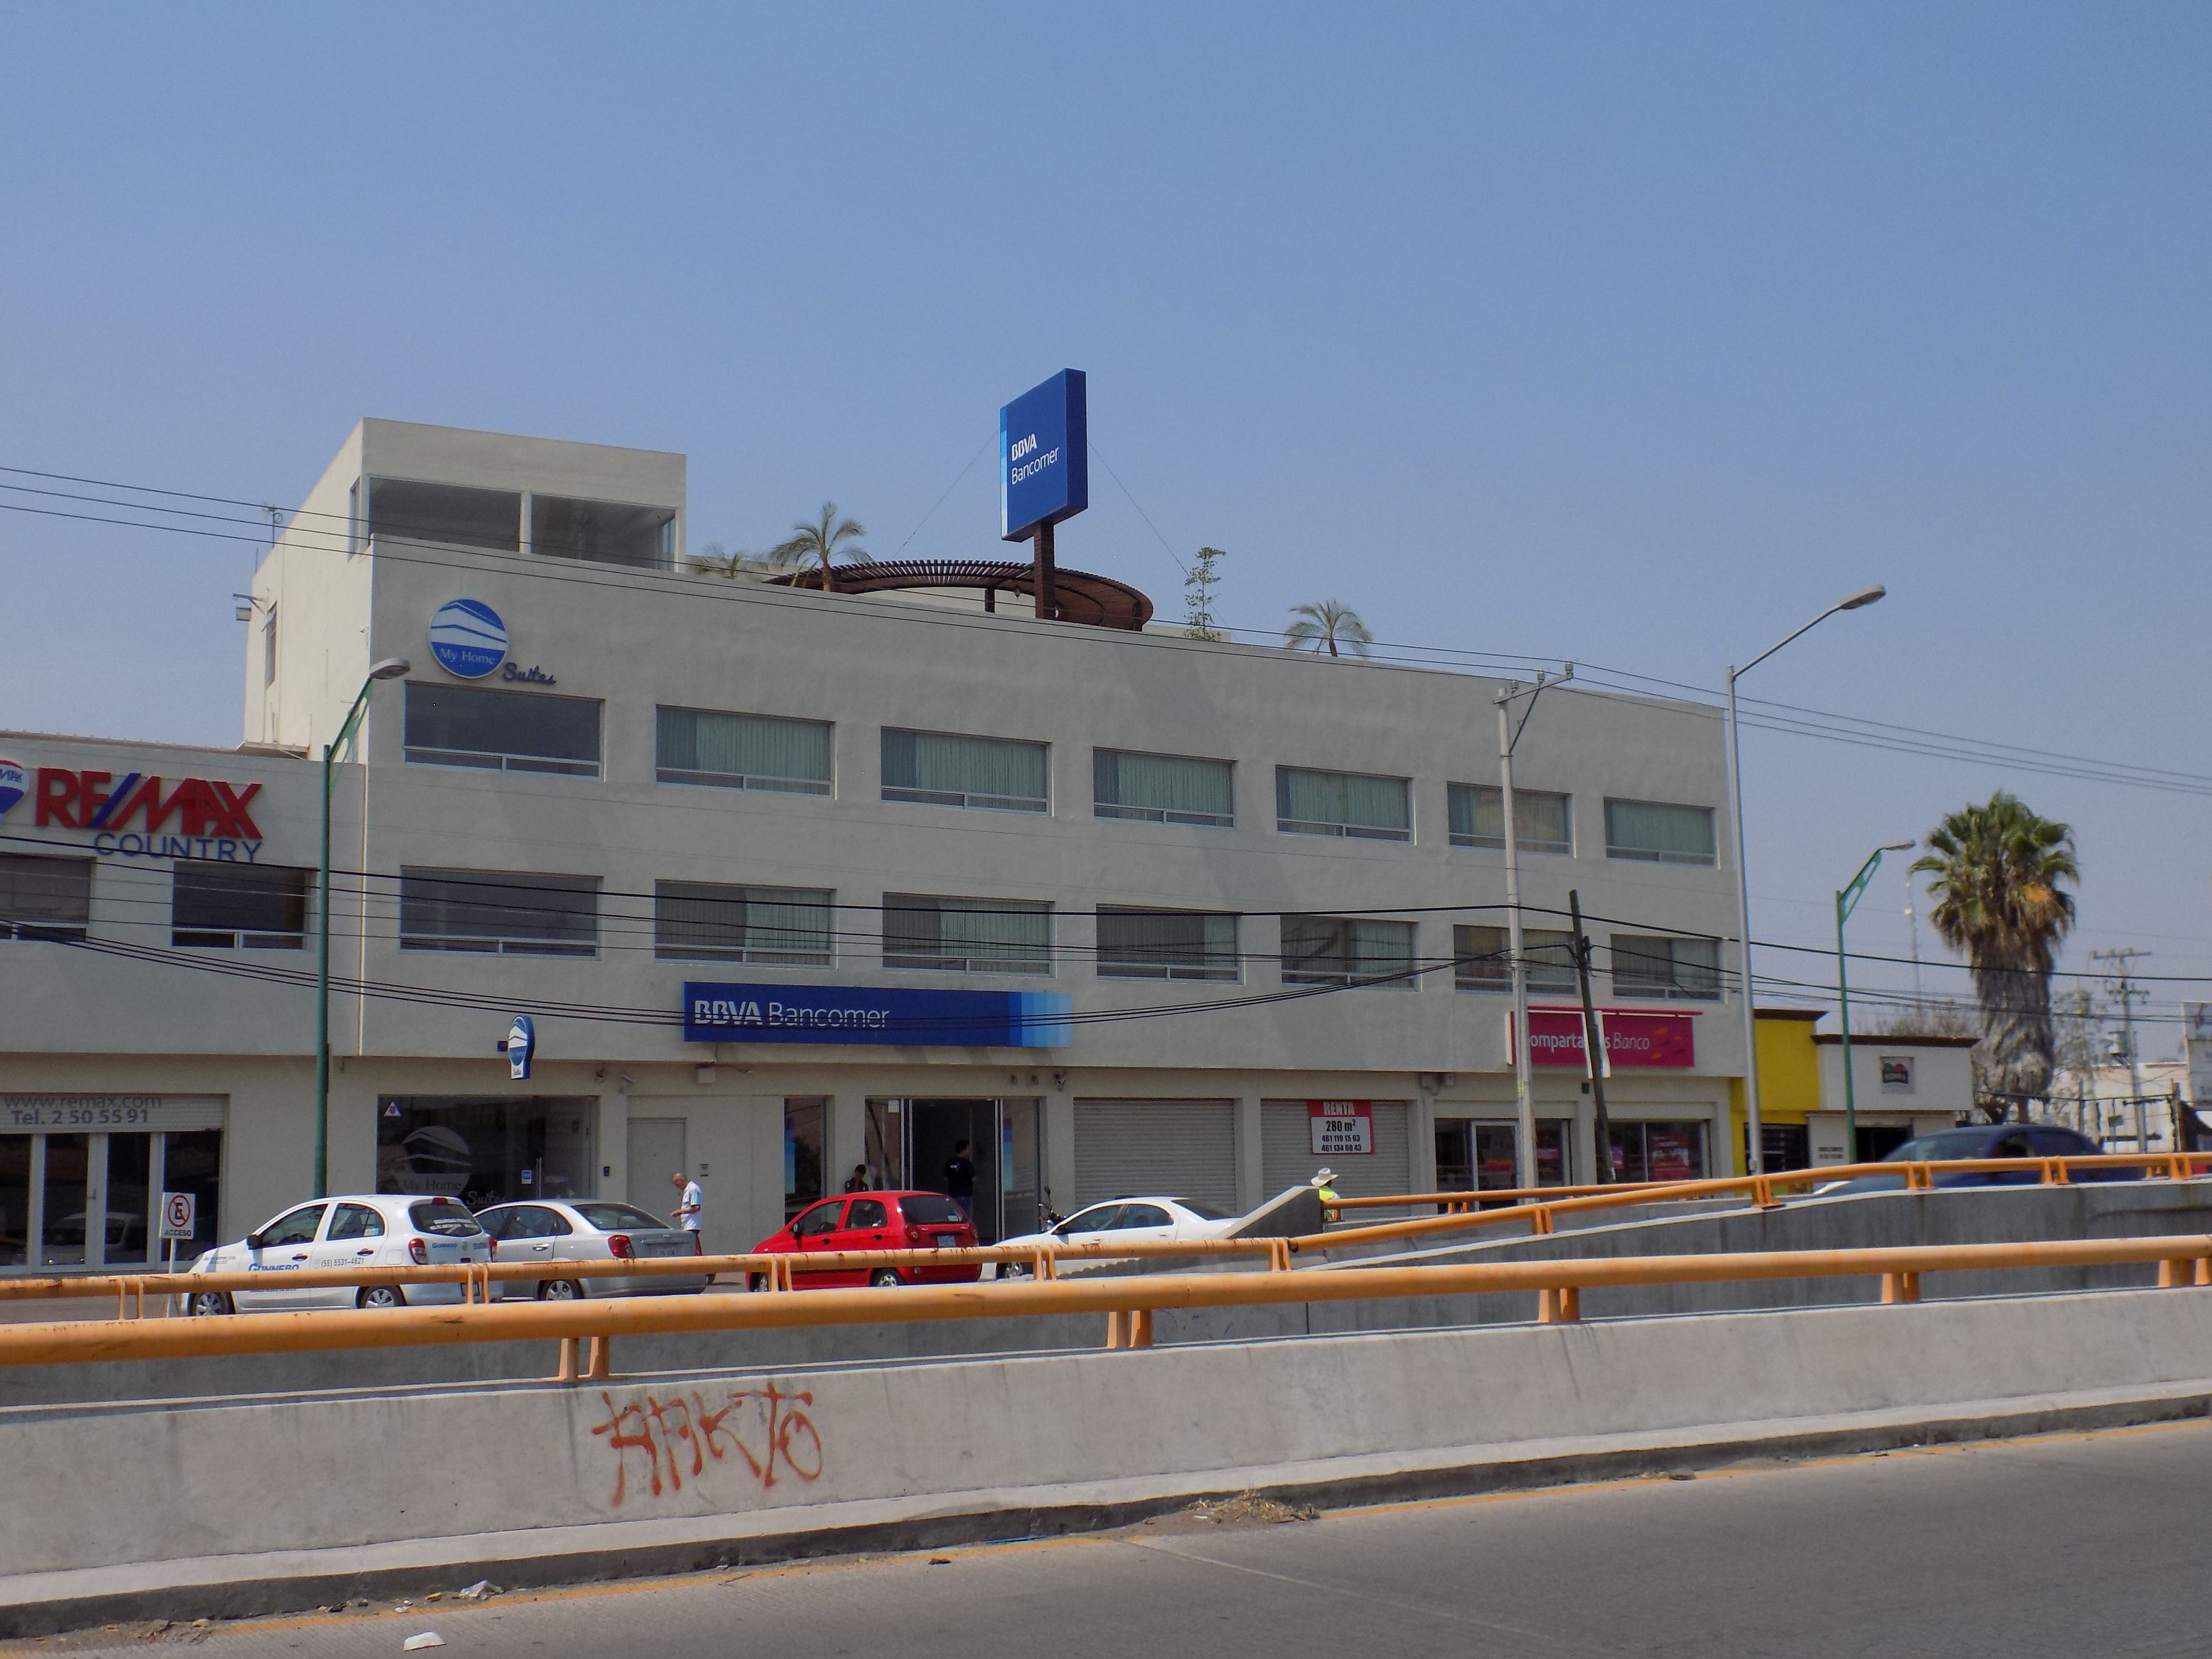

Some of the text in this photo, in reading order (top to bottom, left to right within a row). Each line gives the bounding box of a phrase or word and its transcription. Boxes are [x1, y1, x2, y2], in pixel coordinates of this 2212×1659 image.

[1012, 433, 1037, 461] BBVA
[1012, 447, 1059, 485] Bancomer
[440, 648, 495, 664] My Home
[502, 662, 556, 685] Suites
[93, 833, 263, 863] COUNTRY
[695, 1000, 891, 1028] BBVA Bancomer
[1529, 1032, 1650, 1053] ompartas Banco
[10, 1109, 148, 1124] Tel. 2 50 55 91
[1323, 1101, 1355, 1116] RENTA
[1325, 1120, 1342, 1132] 280
[165, 1229, 192, 1237] ACCESO
[321, 1259, 332, 1268] (55)
